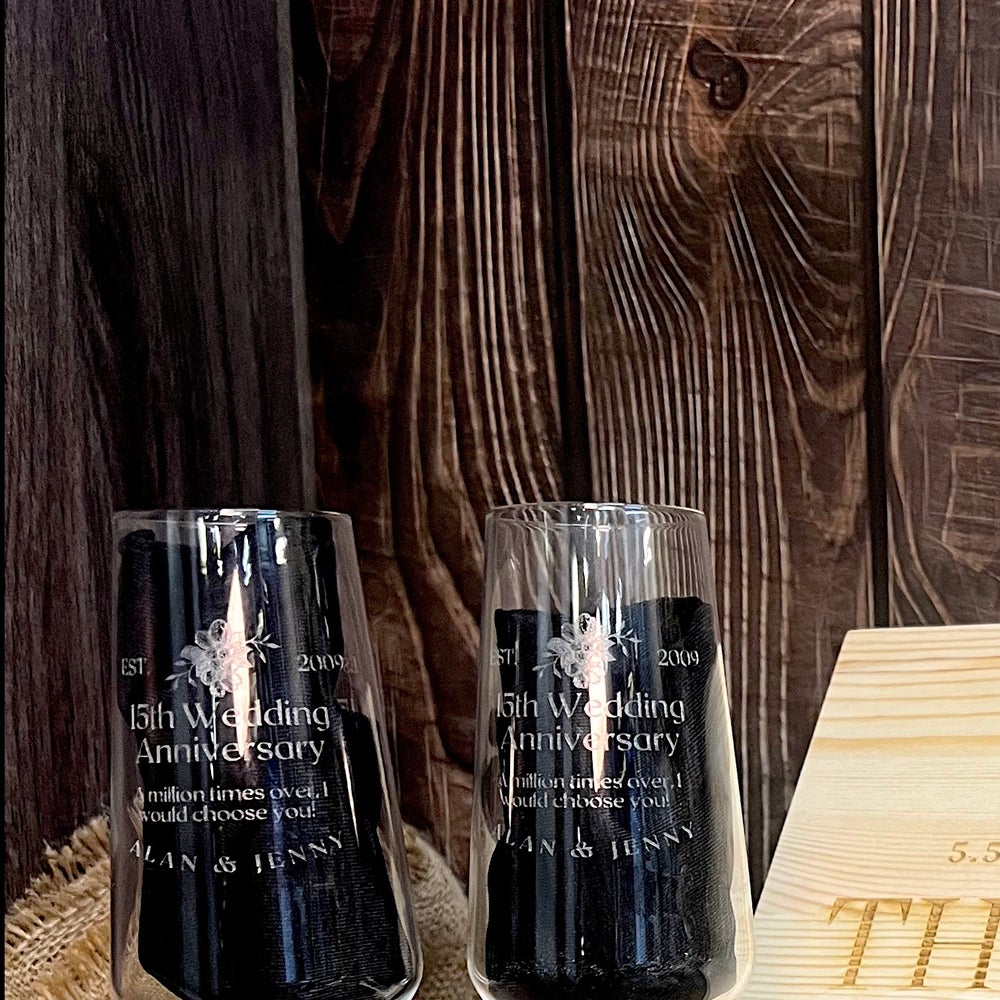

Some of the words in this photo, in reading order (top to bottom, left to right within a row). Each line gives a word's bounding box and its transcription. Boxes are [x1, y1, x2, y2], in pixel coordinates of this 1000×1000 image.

[300, 653, 345, 672] 2009
[657, 648, 699, 668] 2009
[130, 700, 175, 730] 15th
[182, 698, 331, 732] Wedding
[496, 693, 539, 718] 15th
[546, 691, 686, 725] Wedding
[135, 736, 325, 765] Anniversary
[500, 725, 680, 757] Anniversary
[147, 785, 206, 803] million
[209, 785, 266, 802] times
[512, 772, 566, 790] million
[568, 773, 623, 790] times
[191, 804, 269, 821] choose
[271, 801, 317, 824] you!
[499, 788, 549, 809] would
[552, 791, 625, 809] choose
[630, 794, 671, 812] you!
[129, 839, 198, 873] ALAN
[213, 856, 237, 873] &
[254, 831, 343, 874] JENNY
[569, 842, 593, 859] &
[611, 821, 693, 861] JENNY
